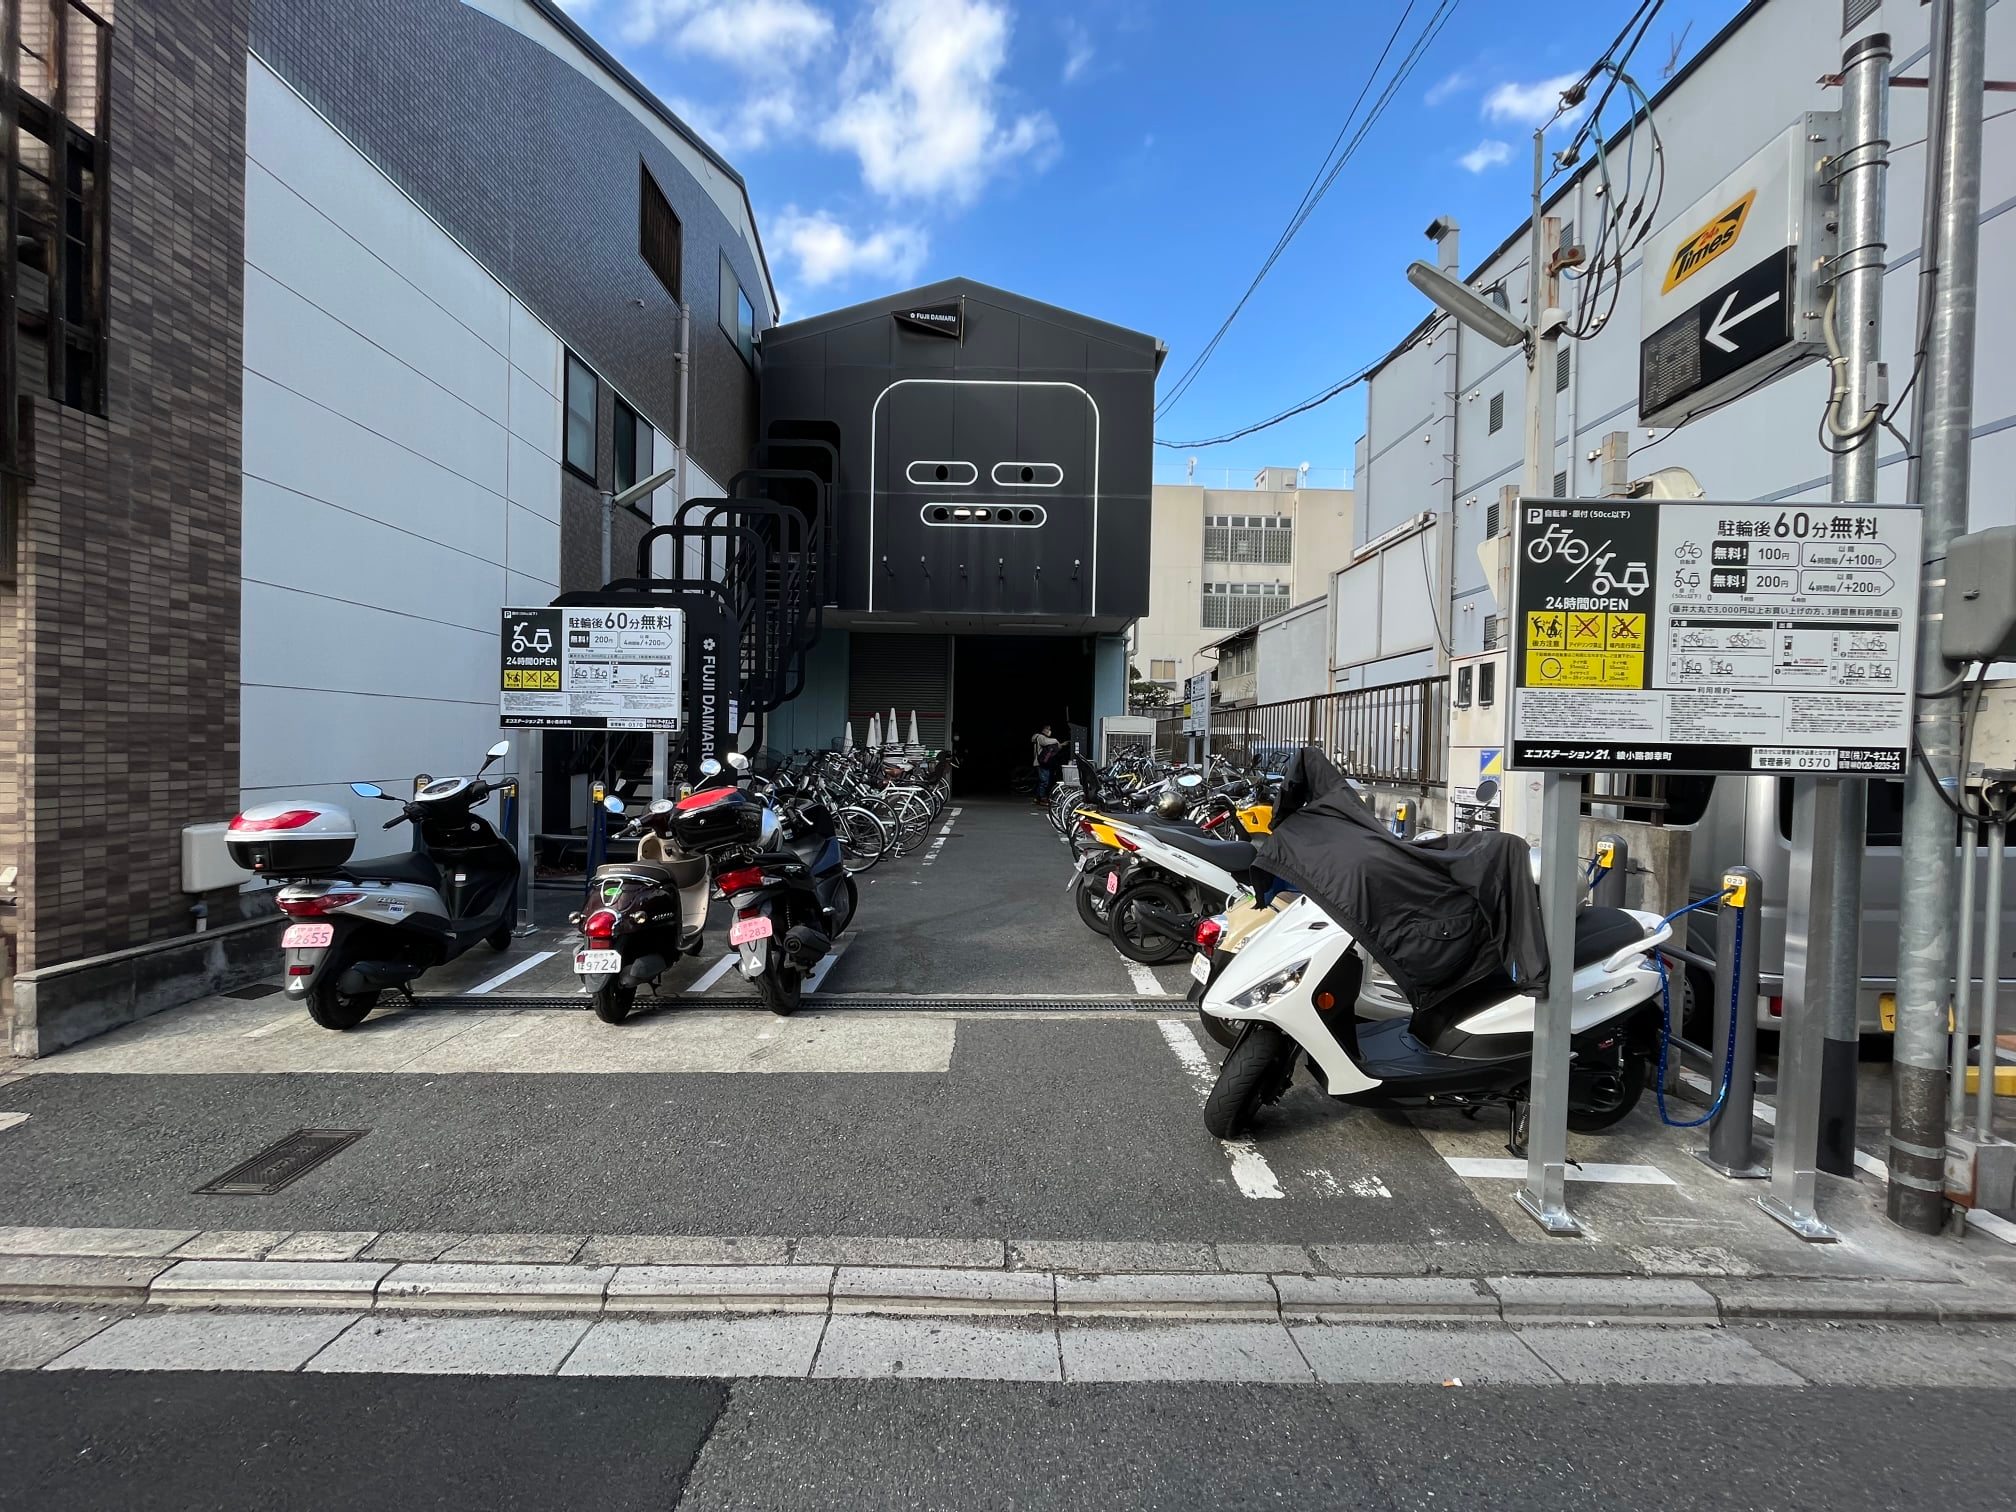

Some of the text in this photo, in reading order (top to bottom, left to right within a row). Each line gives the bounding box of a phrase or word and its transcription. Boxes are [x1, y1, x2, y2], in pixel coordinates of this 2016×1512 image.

[1672, 224, 1737, 281] Times
[931, 314, 956, 322] DAIMARU
[1717, 511, 1879, 540] 駐輪後60分無料
[1758, 548, 1790, 560] 100円
[1756, 575, 1789, 588] 200円
[1545, 596, 1629, 611] 24時間OPEN
[568, 612, 672, 630] 駐輪後60分無料
[702, 655, 716, 691] FUJII
[1759, 757, 1831, 768] 管理番号 0370
[294, 931, 329, 945] 2655
[586, 958, 618, 971] 9724
